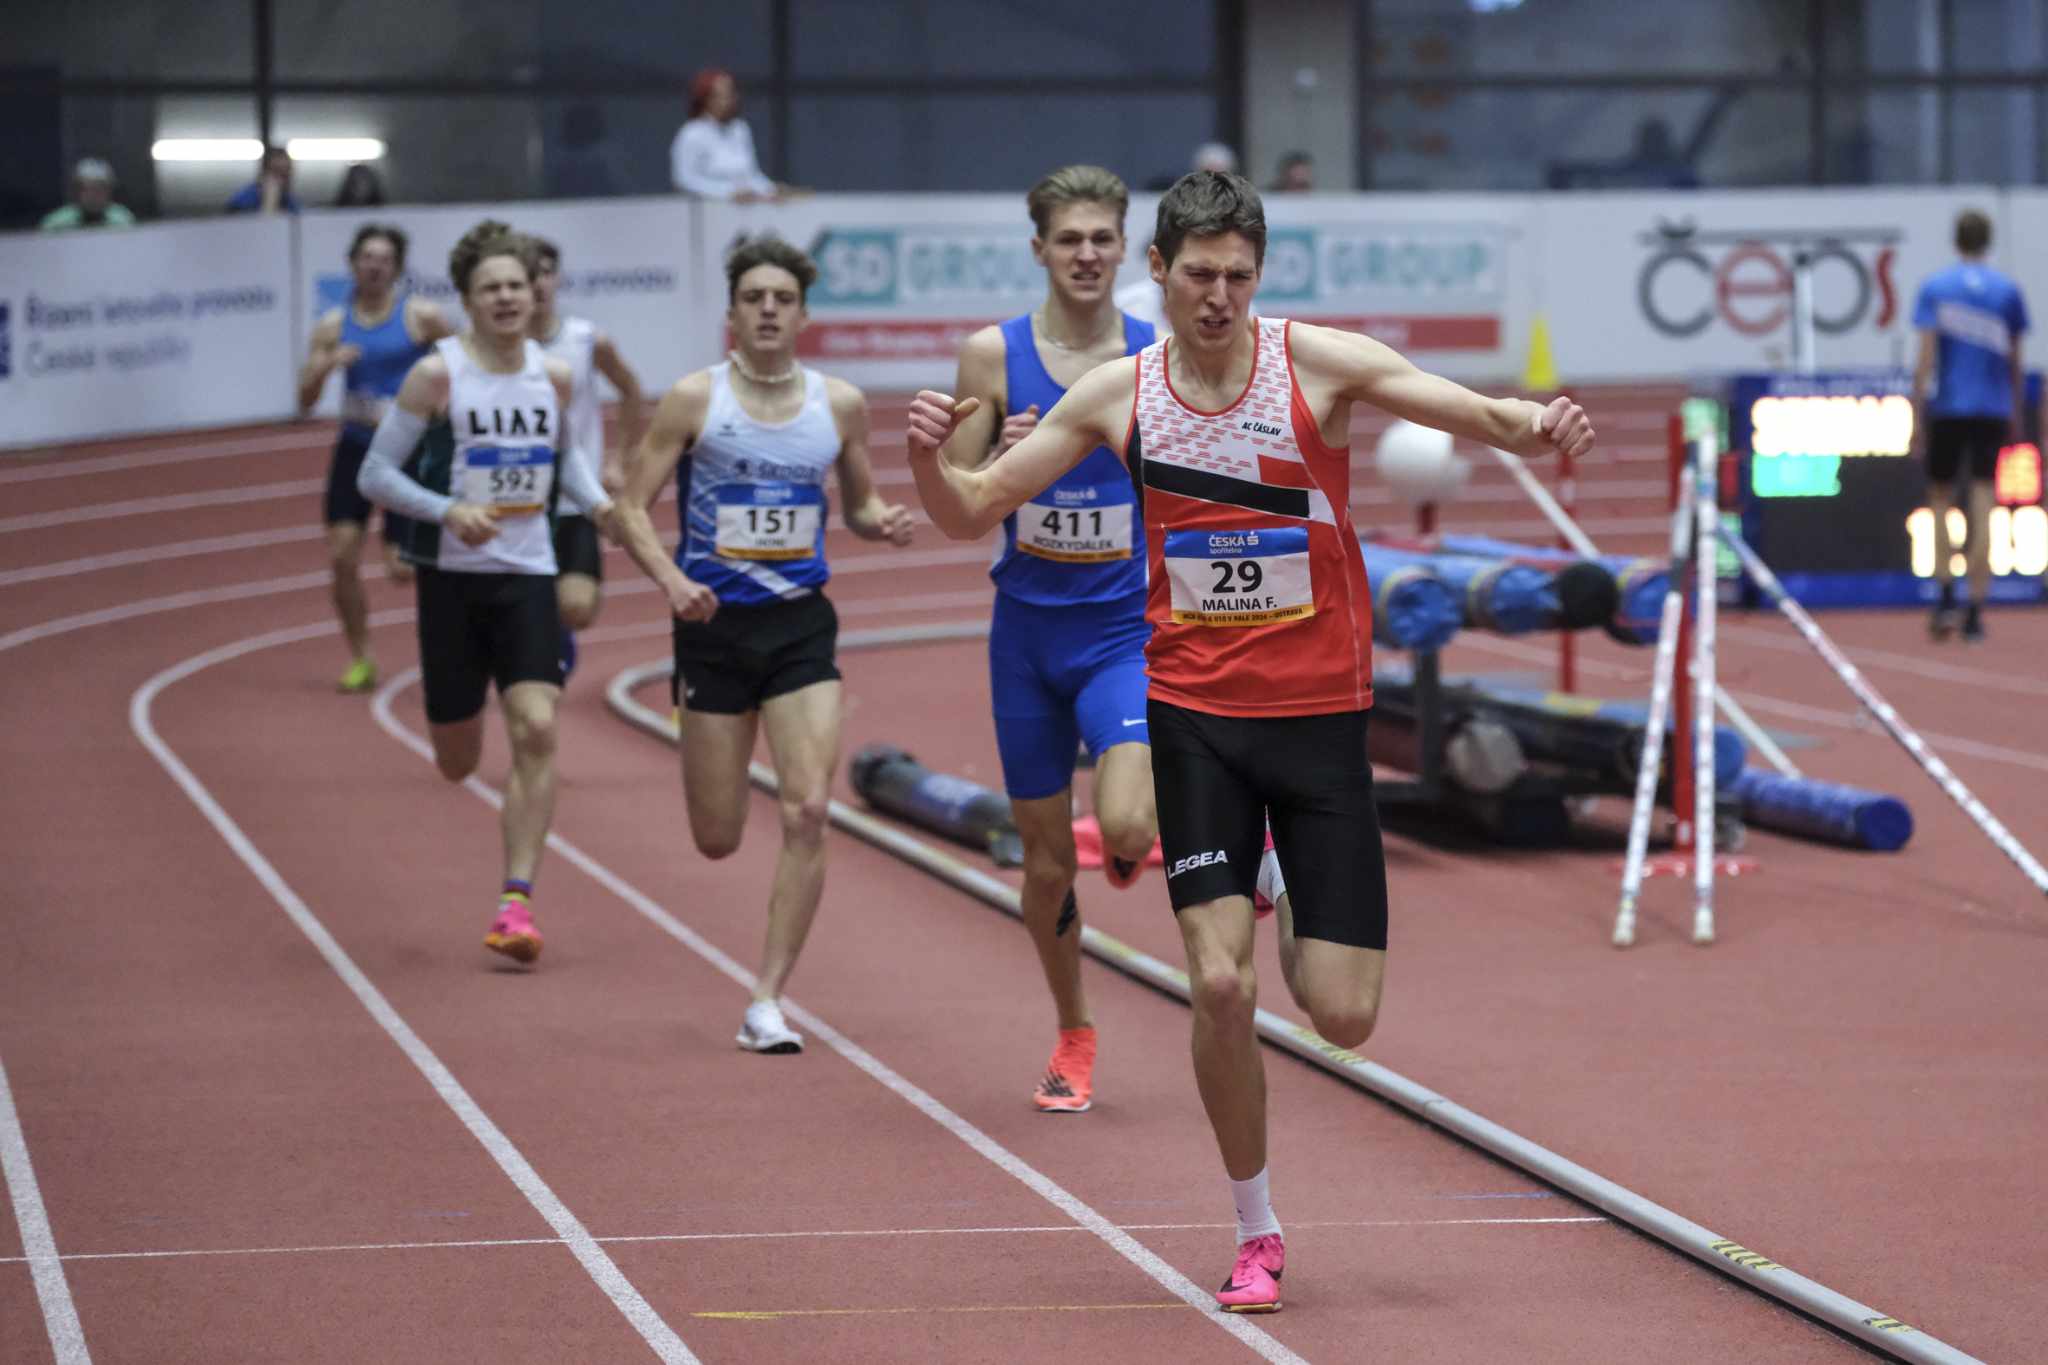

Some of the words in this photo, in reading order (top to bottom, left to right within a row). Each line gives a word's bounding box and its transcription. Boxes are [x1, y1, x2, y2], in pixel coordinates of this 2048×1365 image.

[908, 241, 1039, 290] GROU
[1328, 240, 1490, 288] GROUP
[469, 408, 548, 435] LIAZ
[1241, 421, 1252, 430] AC
[1253, 421, 1282, 436] ČÁSLAV
[489, 468, 536, 493] 592
[747, 508, 796, 534] 151
[1042, 510, 1102, 537] 411
[1208, 534, 1246, 547] ČESKÁ
[1211, 560, 1263, 593] 29
[1202, 598, 1262, 611] MALINA
[1265, 596, 1278, 609] F.
[1167, 850, 1228, 879] LEGEA
